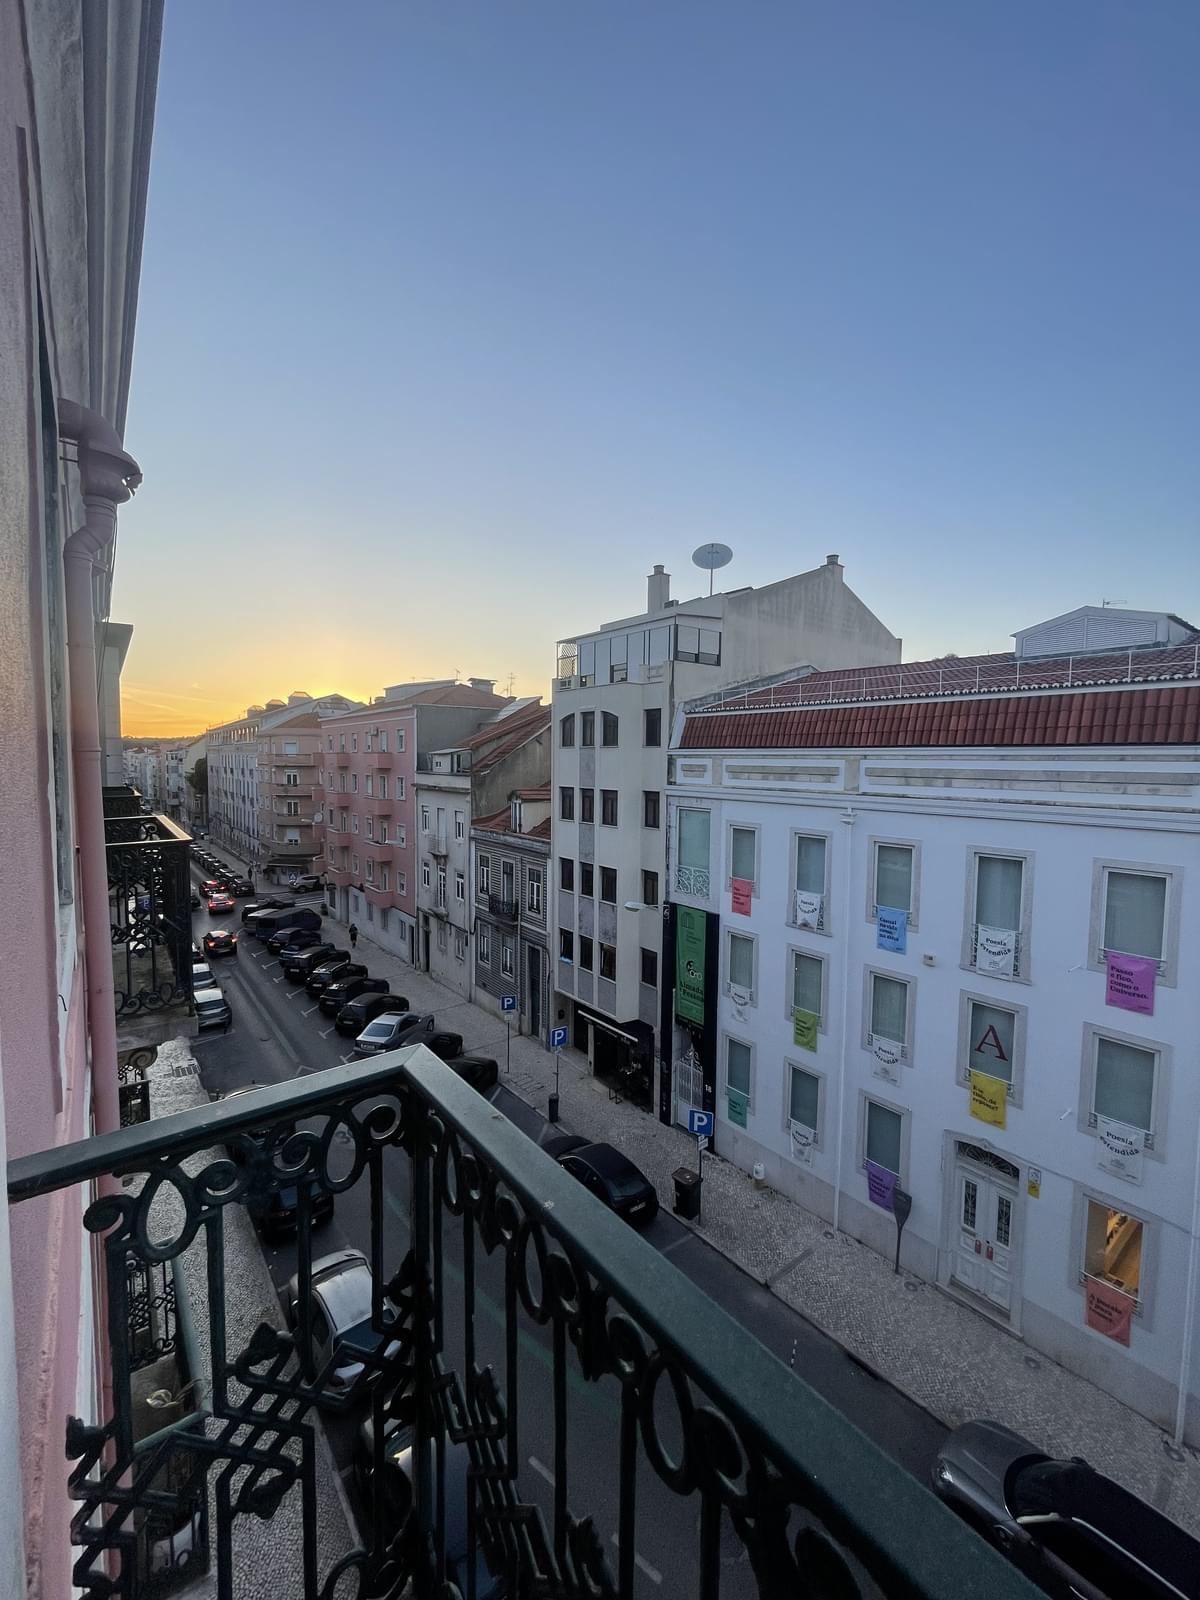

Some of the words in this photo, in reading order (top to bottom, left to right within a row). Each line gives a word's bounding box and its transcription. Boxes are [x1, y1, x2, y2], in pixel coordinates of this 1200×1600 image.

[986, 937, 1007, 947] Poesia
[1111, 965, 1134, 976] Passo
[1111, 980, 1132, 990] como
[1111, 985, 1149, 999] Universo.
[504, 997, 513, 1009] P
[554, 1029, 565, 1046] P
[974, 1024, 1009, 1062] A
[693, 1112, 708, 1132] P
[1106, 1131, 1134, 1146] Poesia
